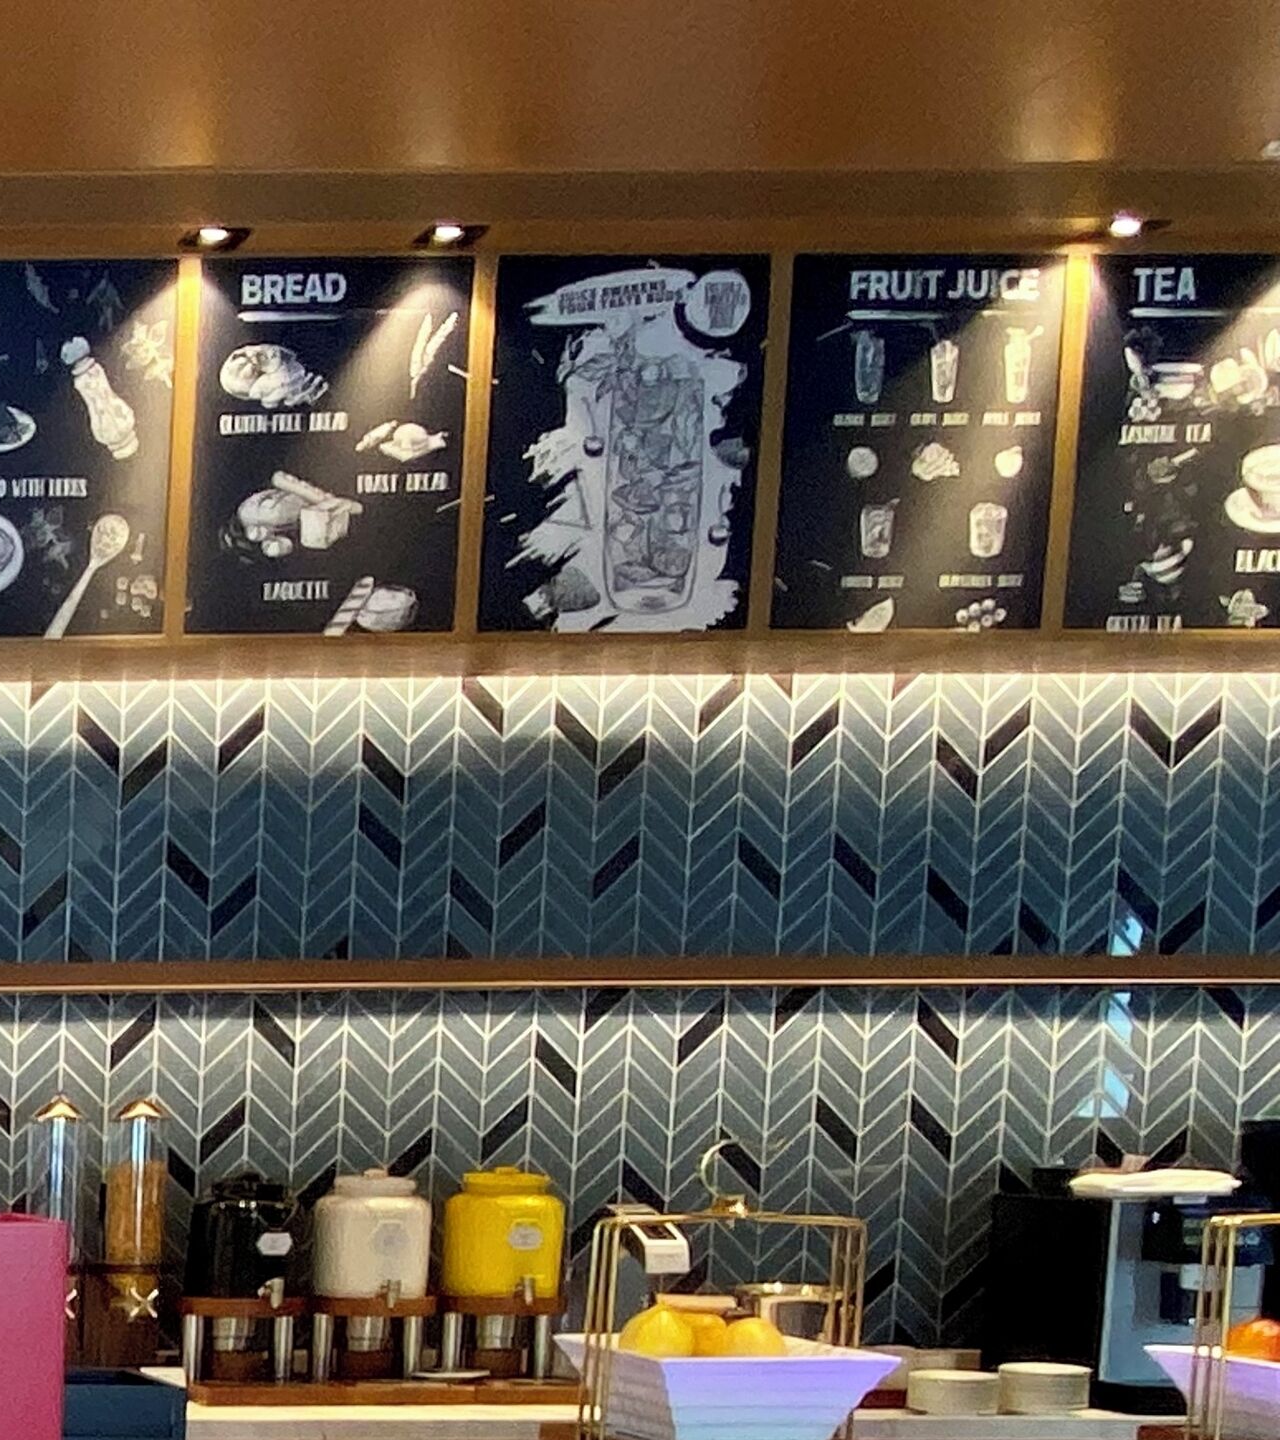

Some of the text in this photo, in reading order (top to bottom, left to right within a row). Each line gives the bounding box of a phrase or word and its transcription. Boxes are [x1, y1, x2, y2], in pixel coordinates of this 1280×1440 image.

[241, 273, 347, 305] BREAD
[850, 269, 1041, 300] FRUIT JUICE
[1134, 267, 1197, 302] TEA
[1235, 549, 1280, 573] BLAC
